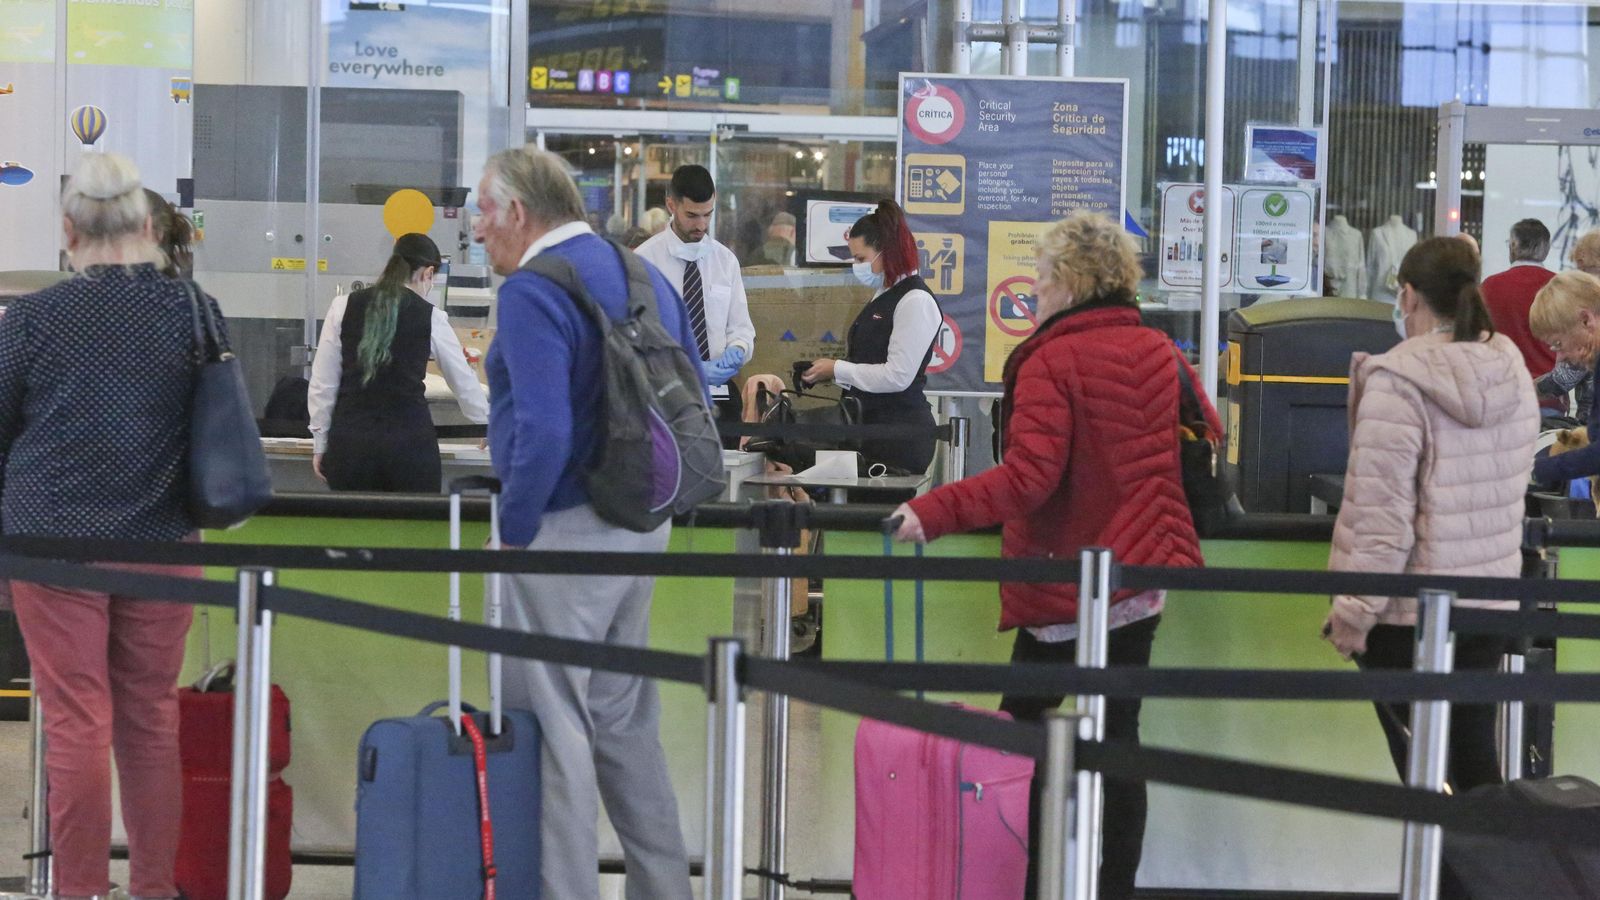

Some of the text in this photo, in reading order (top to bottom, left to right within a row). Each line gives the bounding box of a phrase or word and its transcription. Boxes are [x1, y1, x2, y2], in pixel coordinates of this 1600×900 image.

[355, 41, 398, 58] Love
[329, 58, 444, 79] everywhere
[979, 99, 1011, 110] Critical
[1053, 102, 1078, 112] Zona
[979, 111, 1016, 123] Security
[1092, 114, 1105, 123] de
[978, 122, 999, 132] Area
[1052, 124, 1106, 135] Seguridad
[978, 161, 1014, 171] Place your
[1085, 161, 1103, 169] para
[978, 170, 1008, 178] personal
[977, 186, 1008, 195] including
[977, 202, 1012, 210] inspection
